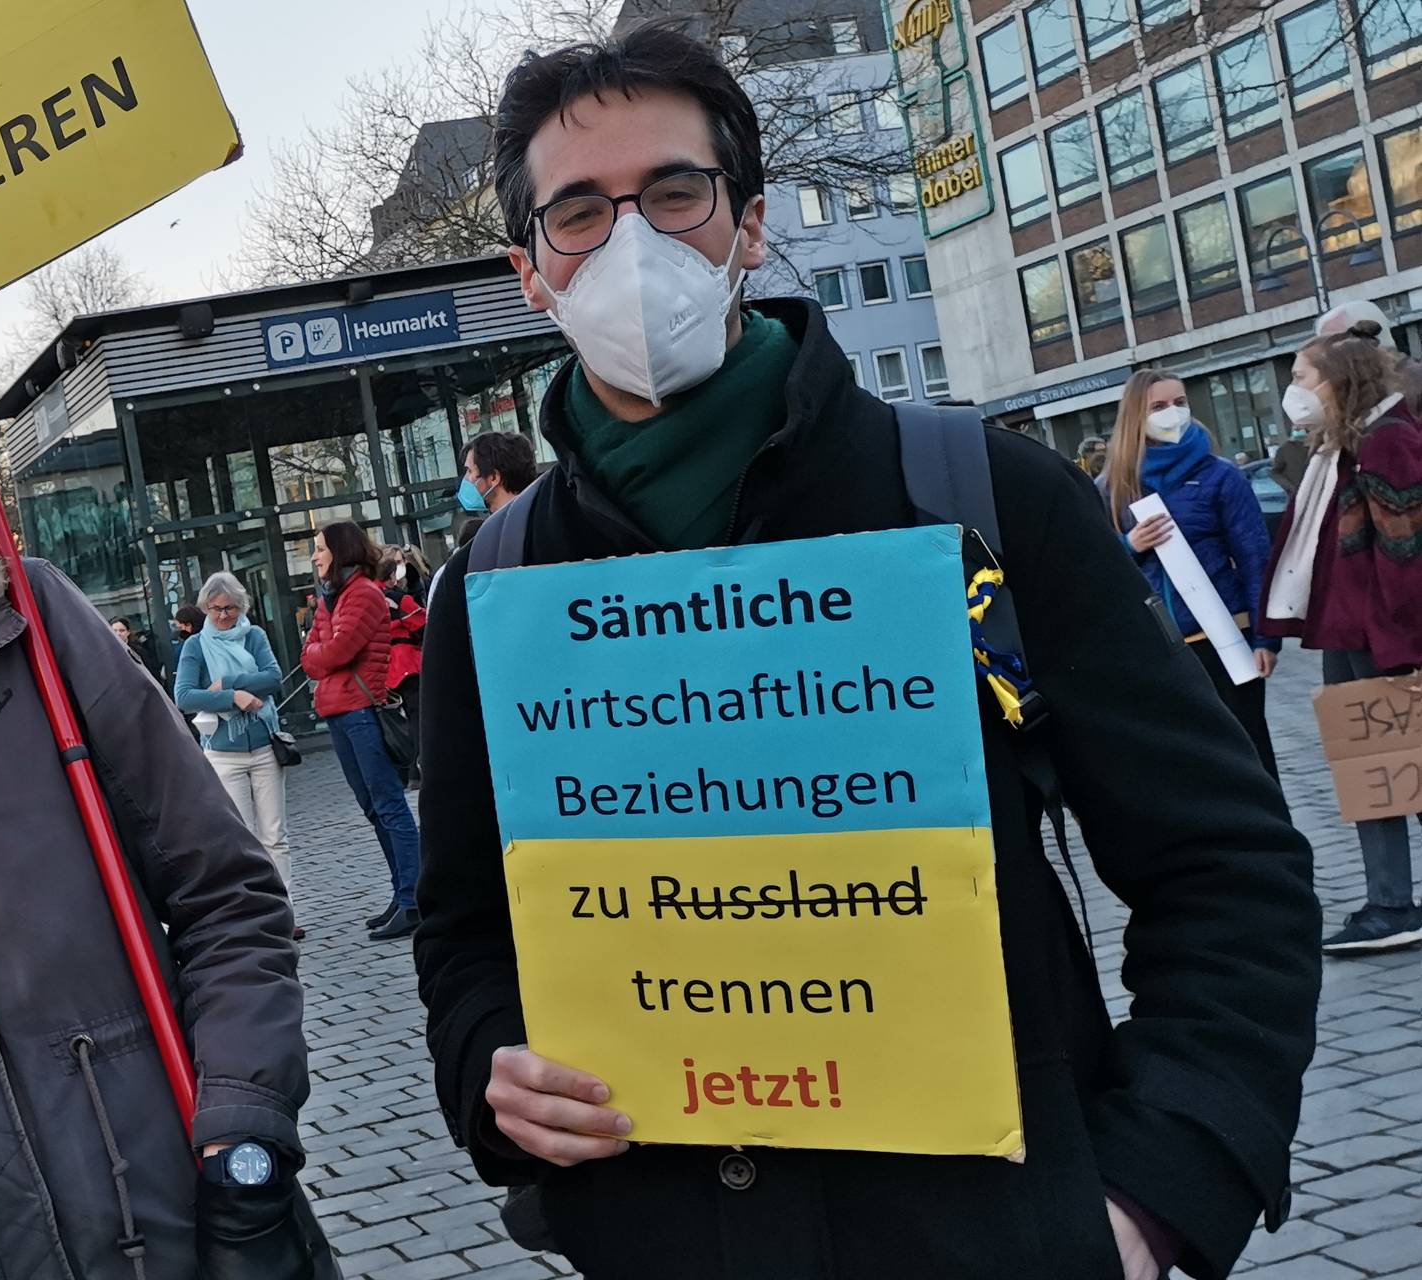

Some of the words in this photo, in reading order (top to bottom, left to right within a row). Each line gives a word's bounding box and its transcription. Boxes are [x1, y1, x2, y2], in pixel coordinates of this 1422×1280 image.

[922, 160, 983, 208] dabei
[353, 310, 449, 340] Heumarkt
[567, 578, 853, 642] Sämtliche
[516, 664, 936, 732] wirtschaftliche
[1345, 692, 1422, 742] ASE
[554, 767, 917, 818] Beziehungen
[1364, 761, 1422, 808] CE
[568, 884, 630, 919] zu
[648, 865, 928, 920] Russland
[631, 969, 875, 1014] trennen
[682, 1057, 843, 1115] jetzt!
